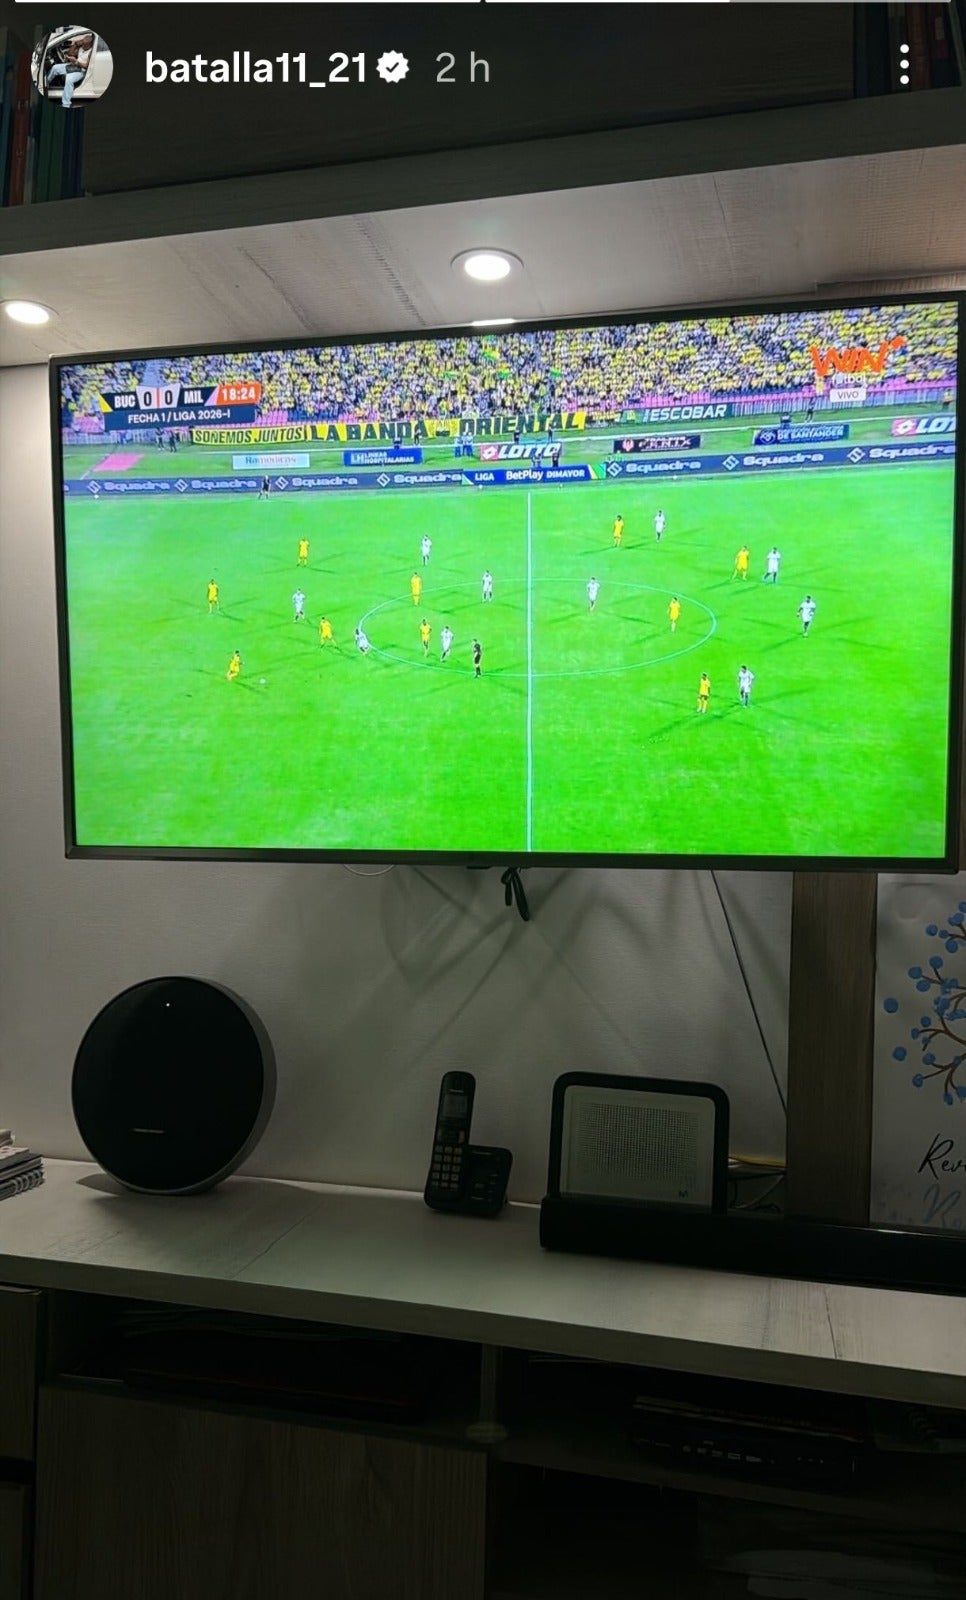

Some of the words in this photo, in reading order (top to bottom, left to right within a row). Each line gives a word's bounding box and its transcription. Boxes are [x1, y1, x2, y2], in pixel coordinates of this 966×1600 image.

[809, 338, 890, 377] WIN
[114, 395, 136, 408] BUC
[143, 391, 153, 406] 0
[164, 390, 173, 405] 0
[184, 390, 203, 404] MIL
[222, 387, 255, 401] 18:24
[837, 391, 859, 399] VIVO
[128, 412, 159, 424] FECHA
[161, 412, 166, 422] 1
[173, 411, 195, 422] LIGA
[650, 404, 727, 422] ESCOBAR
[310, 424, 340, 440] LA
[346, 420, 429, 440] BANDA
[460, 413, 580, 437] ORIENTAL
[254, 427, 302, 442] JUNTOS
[498, 443, 561, 459] LOTTO
[743, 452, 824, 466] Squadra
[626, 460, 701, 473] Squadra
[292, 476, 357, 487] Squadra
[394, 473, 461, 485] Squadra
[475, 472, 495, 482] LIGA
[506, 468, 543, 481] BetPlay
[546, 468, 585, 479] DIMAYOR
[103, 481, 170, 492] Squadra
[191, 479, 257, 490] Squadra
